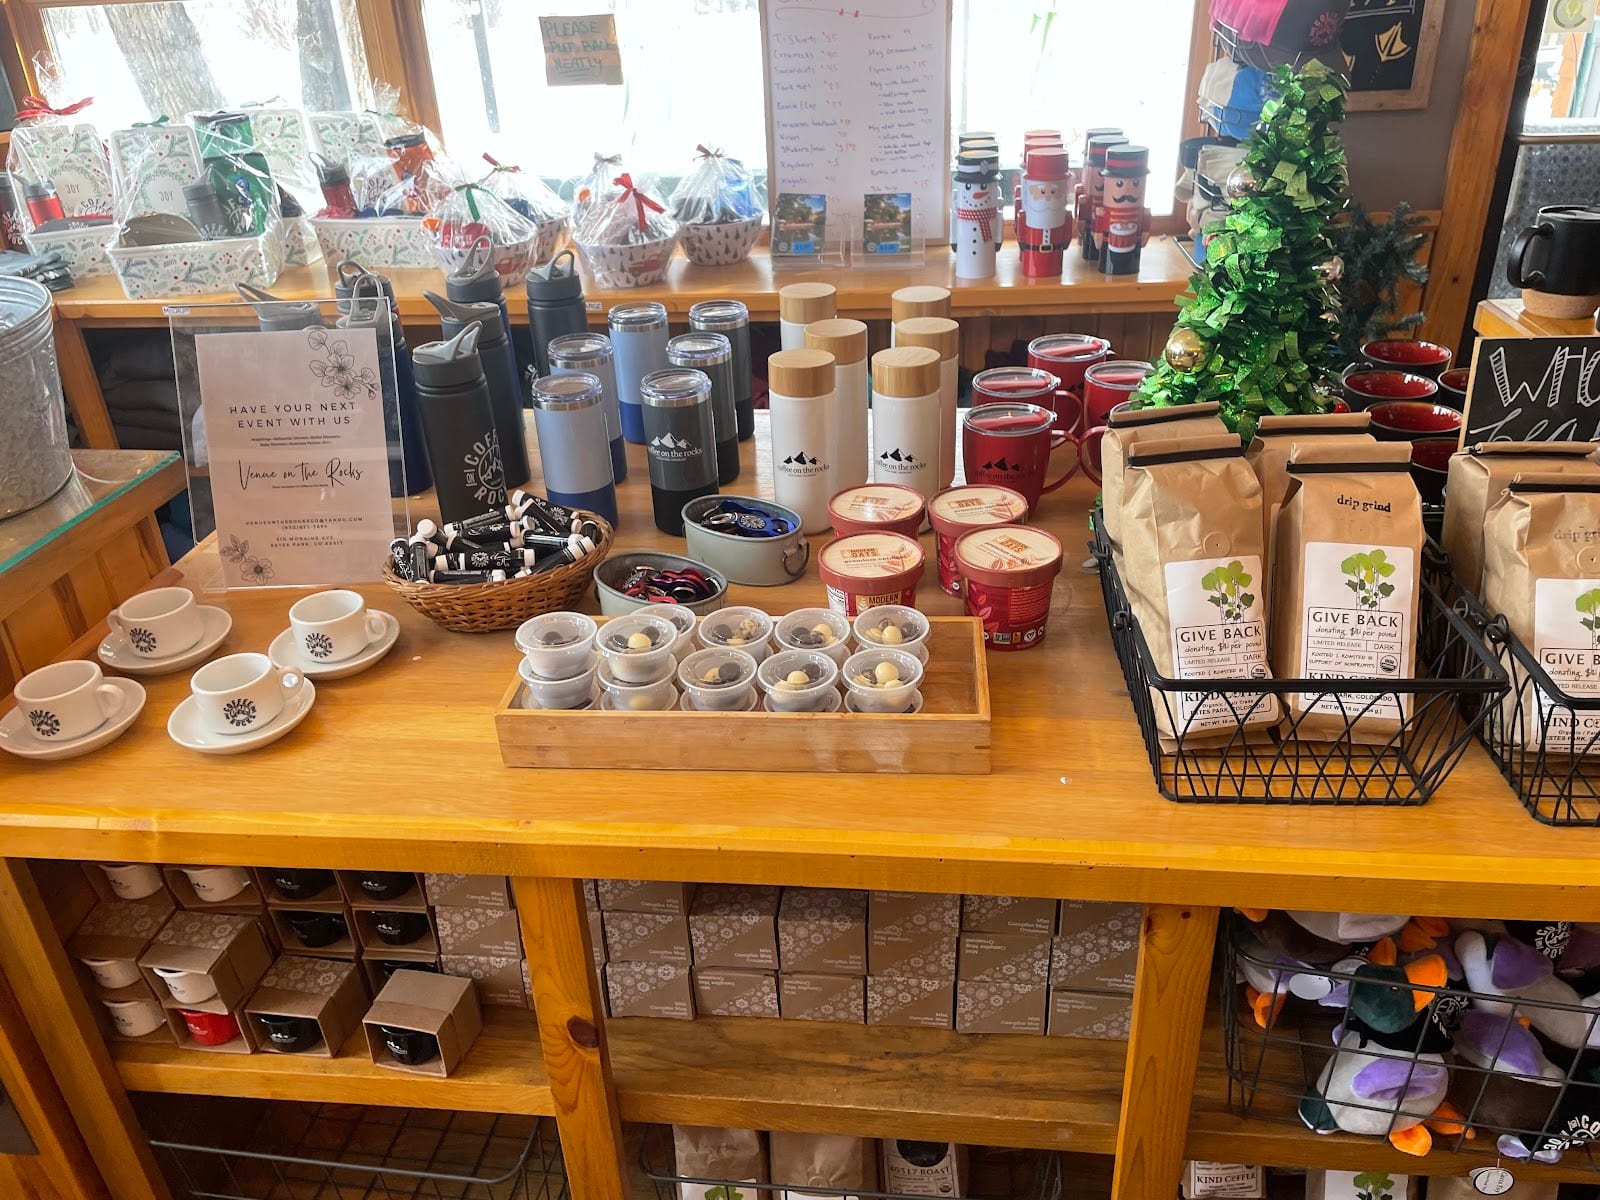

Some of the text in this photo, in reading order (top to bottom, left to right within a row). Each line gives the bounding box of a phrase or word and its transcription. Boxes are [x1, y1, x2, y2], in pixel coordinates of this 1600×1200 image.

[543, 20, 600, 38] PLEASE
[554, 56, 602, 73] NEATLY
[65, 183, 80, 194] JOY
[158, 191, 174, 201] JOY
[229, 402, 356, 415] HAVE YOUR NEXT
[237, 416, 351, 428] EVENT WITH US
[684, 447, 702, 457] rocks
[238, 459, 277, 490] Venue
[282, 470, 296, 479] on
[325, 457, 364, 487] Rocks
[1336, 494, 1392, 512] drip grind
[868, 592, 899, 604] MODERN
[1312, 612, 1398, 627] GIVE BACK
[1180, 626, 1262, 642] GIVE BACK
[1316, 626, 1347, 639] donating
[1362, 630, 1375, 638] per
[1378, 631, 1397, 640] pound
[1184, 644, 1216, 656] donating
[1230, 643, 1243, 652] per
[1246, 642, 1262, 651] pound
[1545, 652, 1585, 665] GIVE
[1548, 668, 1582, 681] donating
[920, 1166, 950, 1176] ROAST
[1197, 1175, 1222, 1184] KIND
